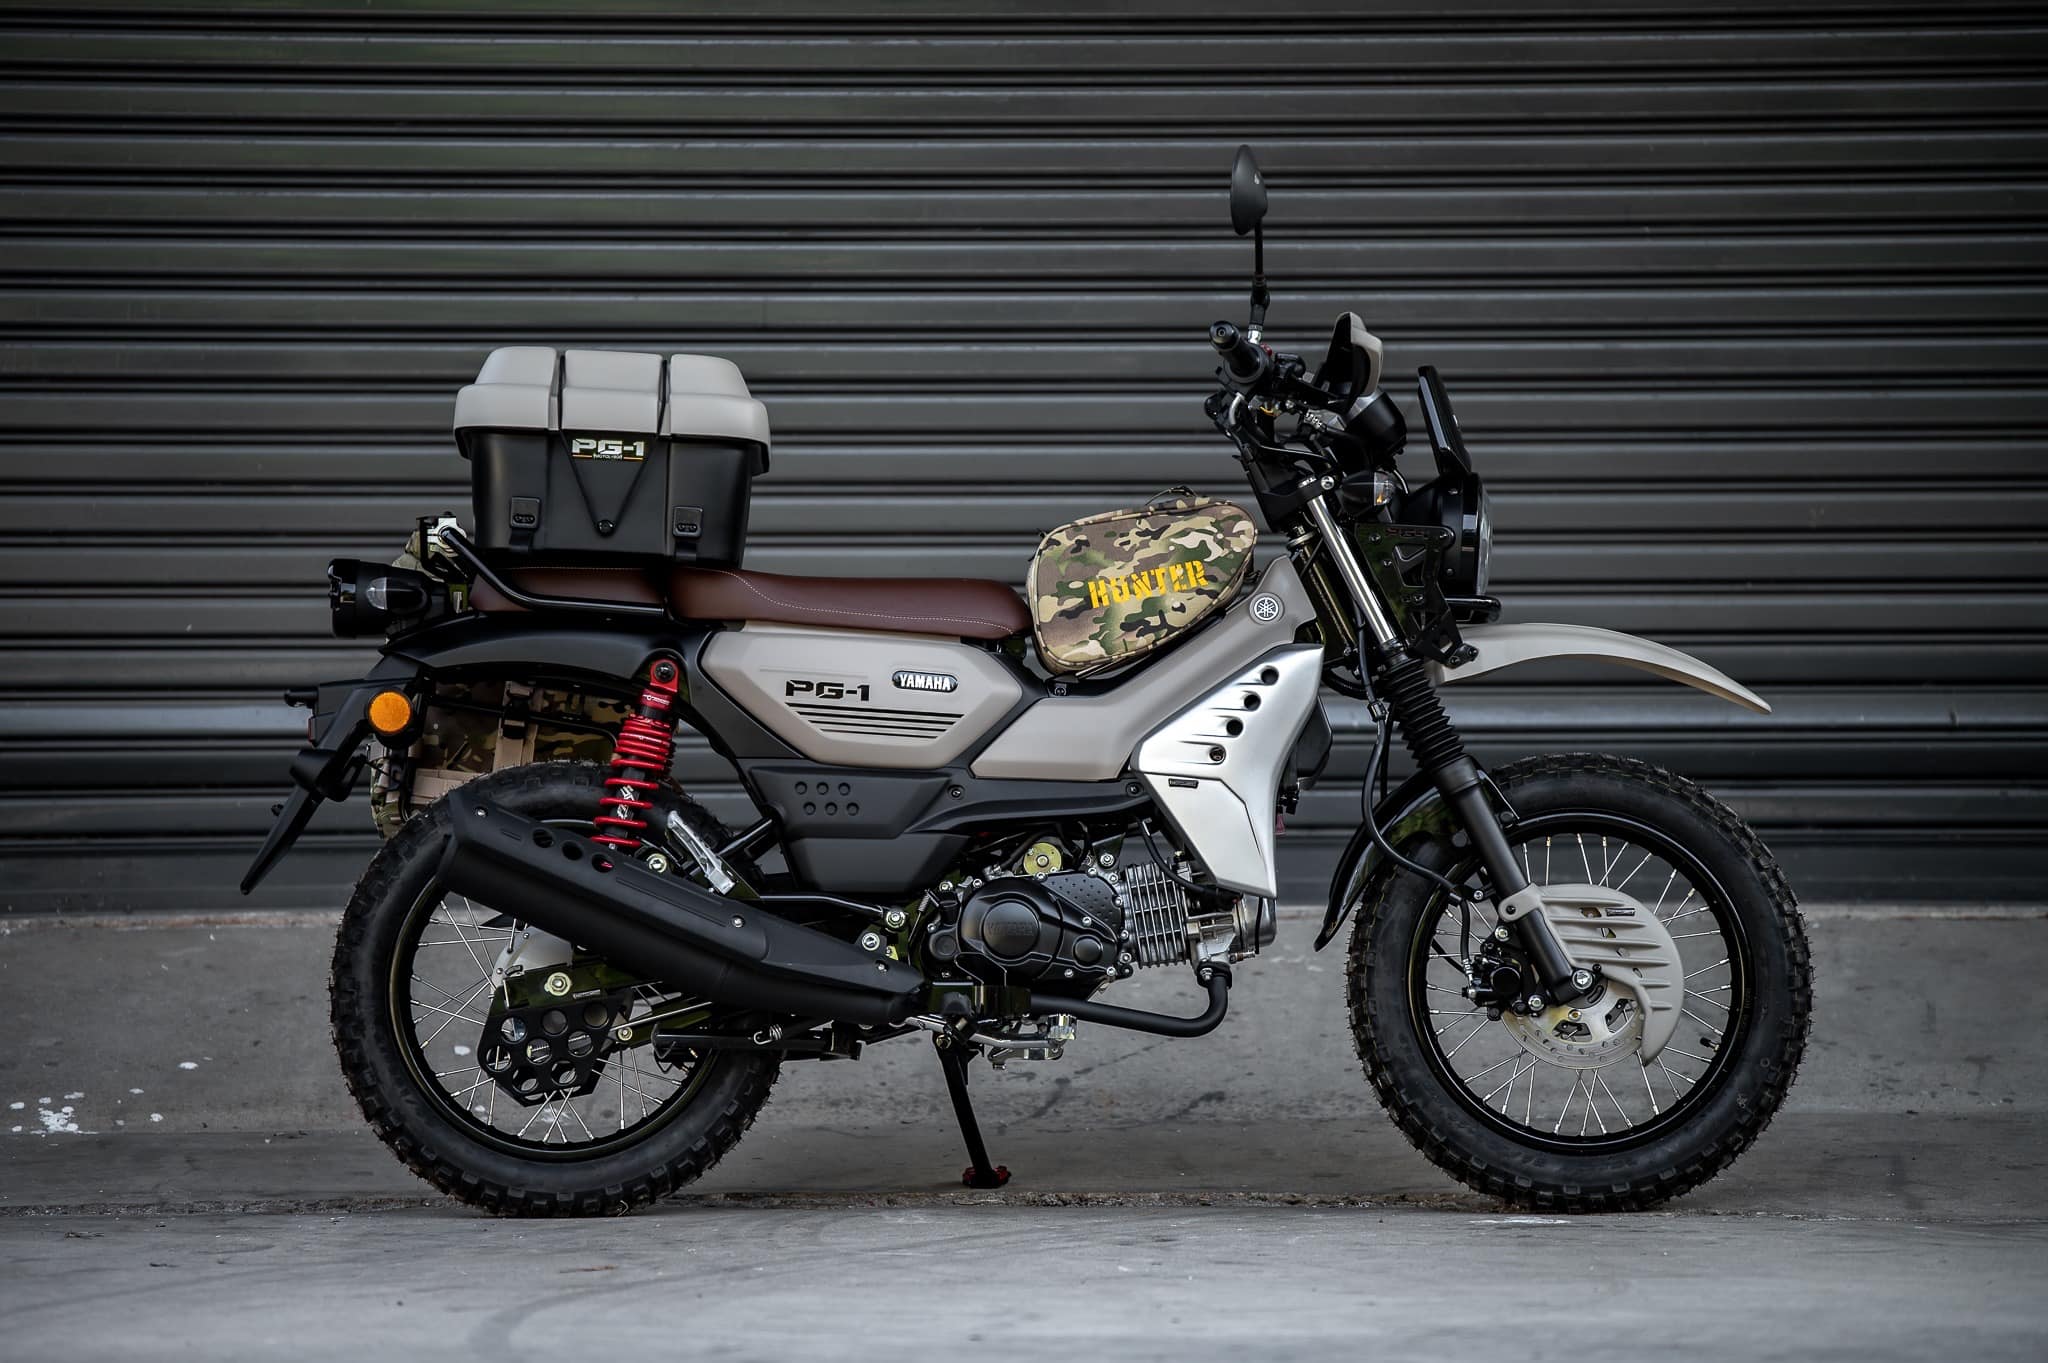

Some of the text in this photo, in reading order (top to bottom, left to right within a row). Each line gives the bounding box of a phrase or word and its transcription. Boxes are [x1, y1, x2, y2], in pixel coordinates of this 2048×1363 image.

[572, 438, 645, 456] PG-1
[1087, 559, 1208, 609] HUNTER
[785, 680, 870, 702] PG-1
[898, 673, 951, 691] YAMAHA
